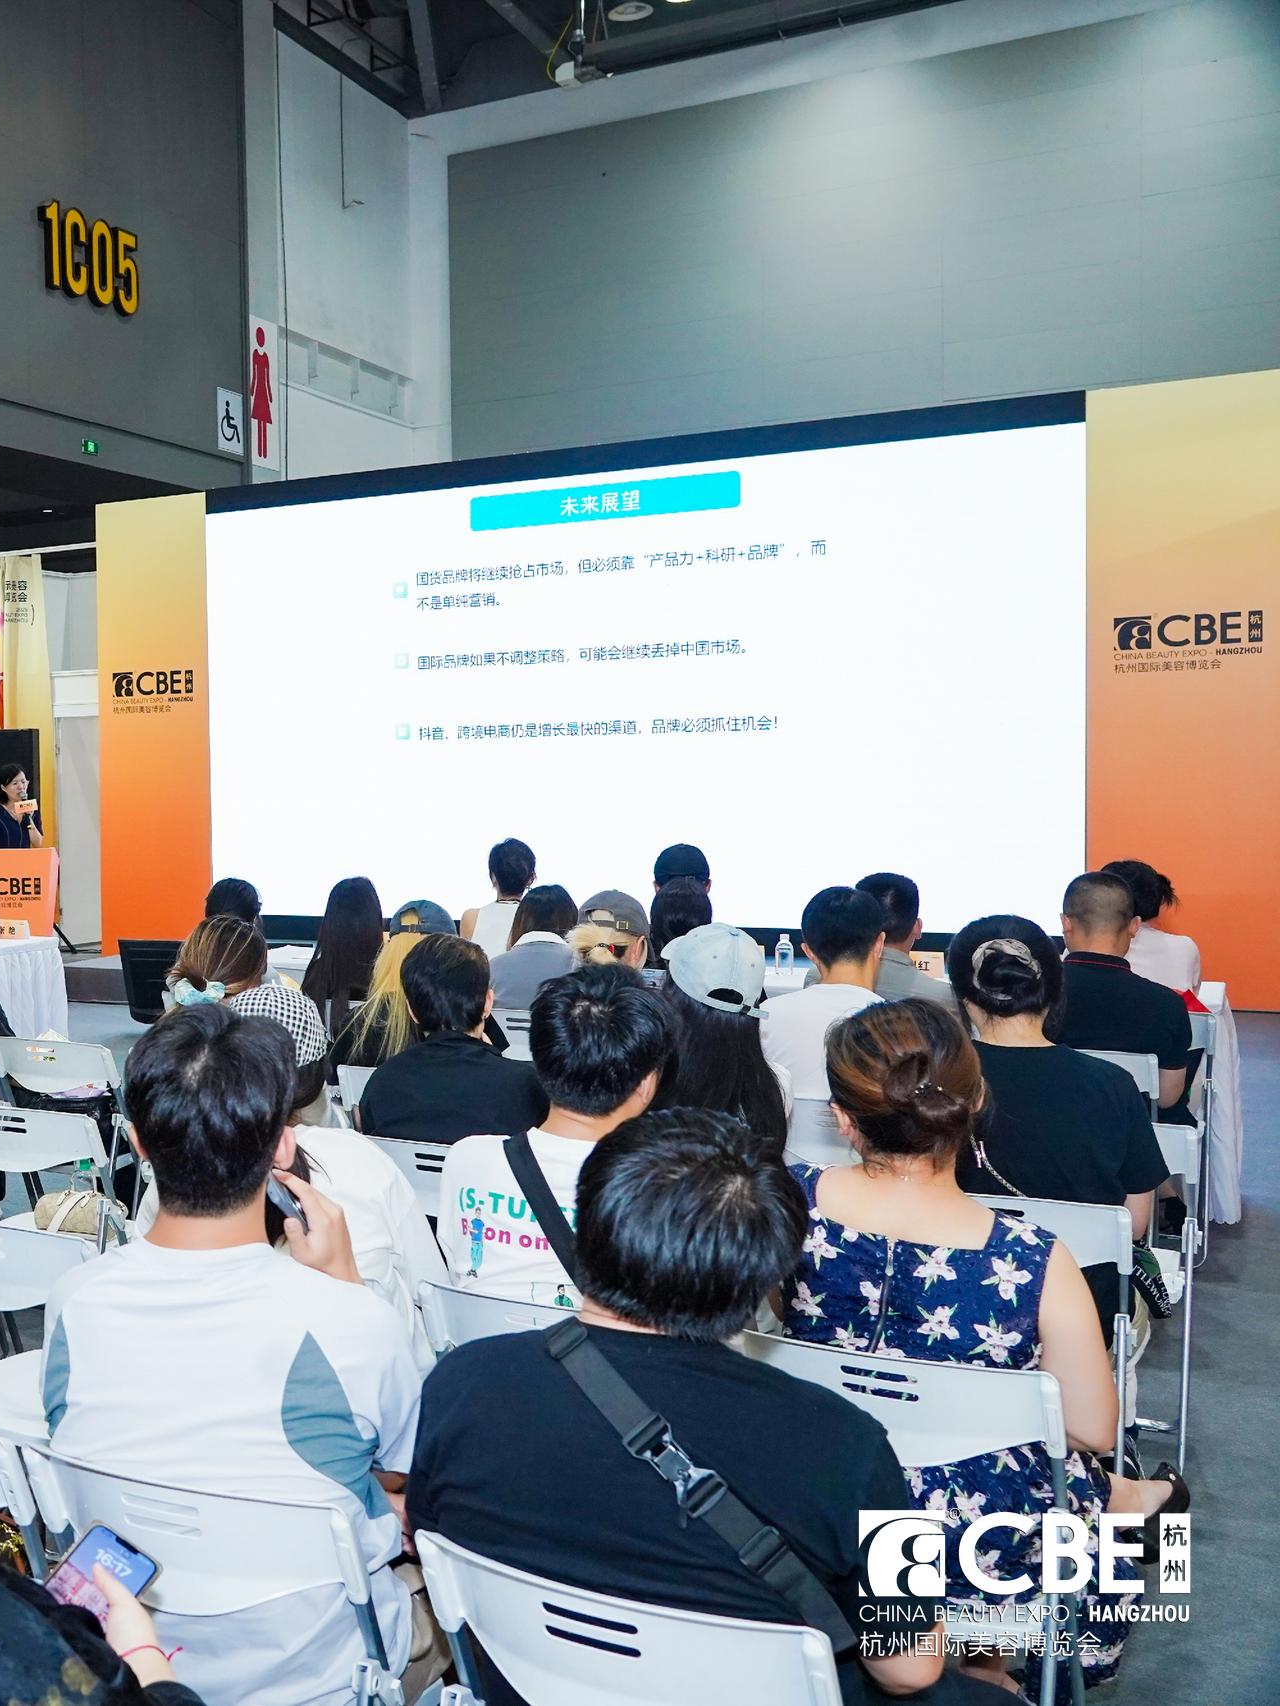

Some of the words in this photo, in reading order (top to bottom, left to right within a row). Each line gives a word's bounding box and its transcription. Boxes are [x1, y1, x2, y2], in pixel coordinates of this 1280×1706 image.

[39, 200, 139, 316] 1C05
[560, 490, 641, 517] 未来展望
[416, 592, 501, 611] 不是单纯营销。
[1157, 611, 1242, 647] CBE
[1249, 613, 1263, 640] 杭州
[1114, 652, 1144, 662] CHINA
[1146, 650, 1180, 661] BEAUTY
[1182, 648, 1207, 658] EXPO
[1215, 646, 1263, 656] HANGZHOU
[1114, 659, 1222, 675] 杭州国际美容博览会
[136, 670, 182, 696] CBE
[95, 1548, 133, 1577] 16:17
